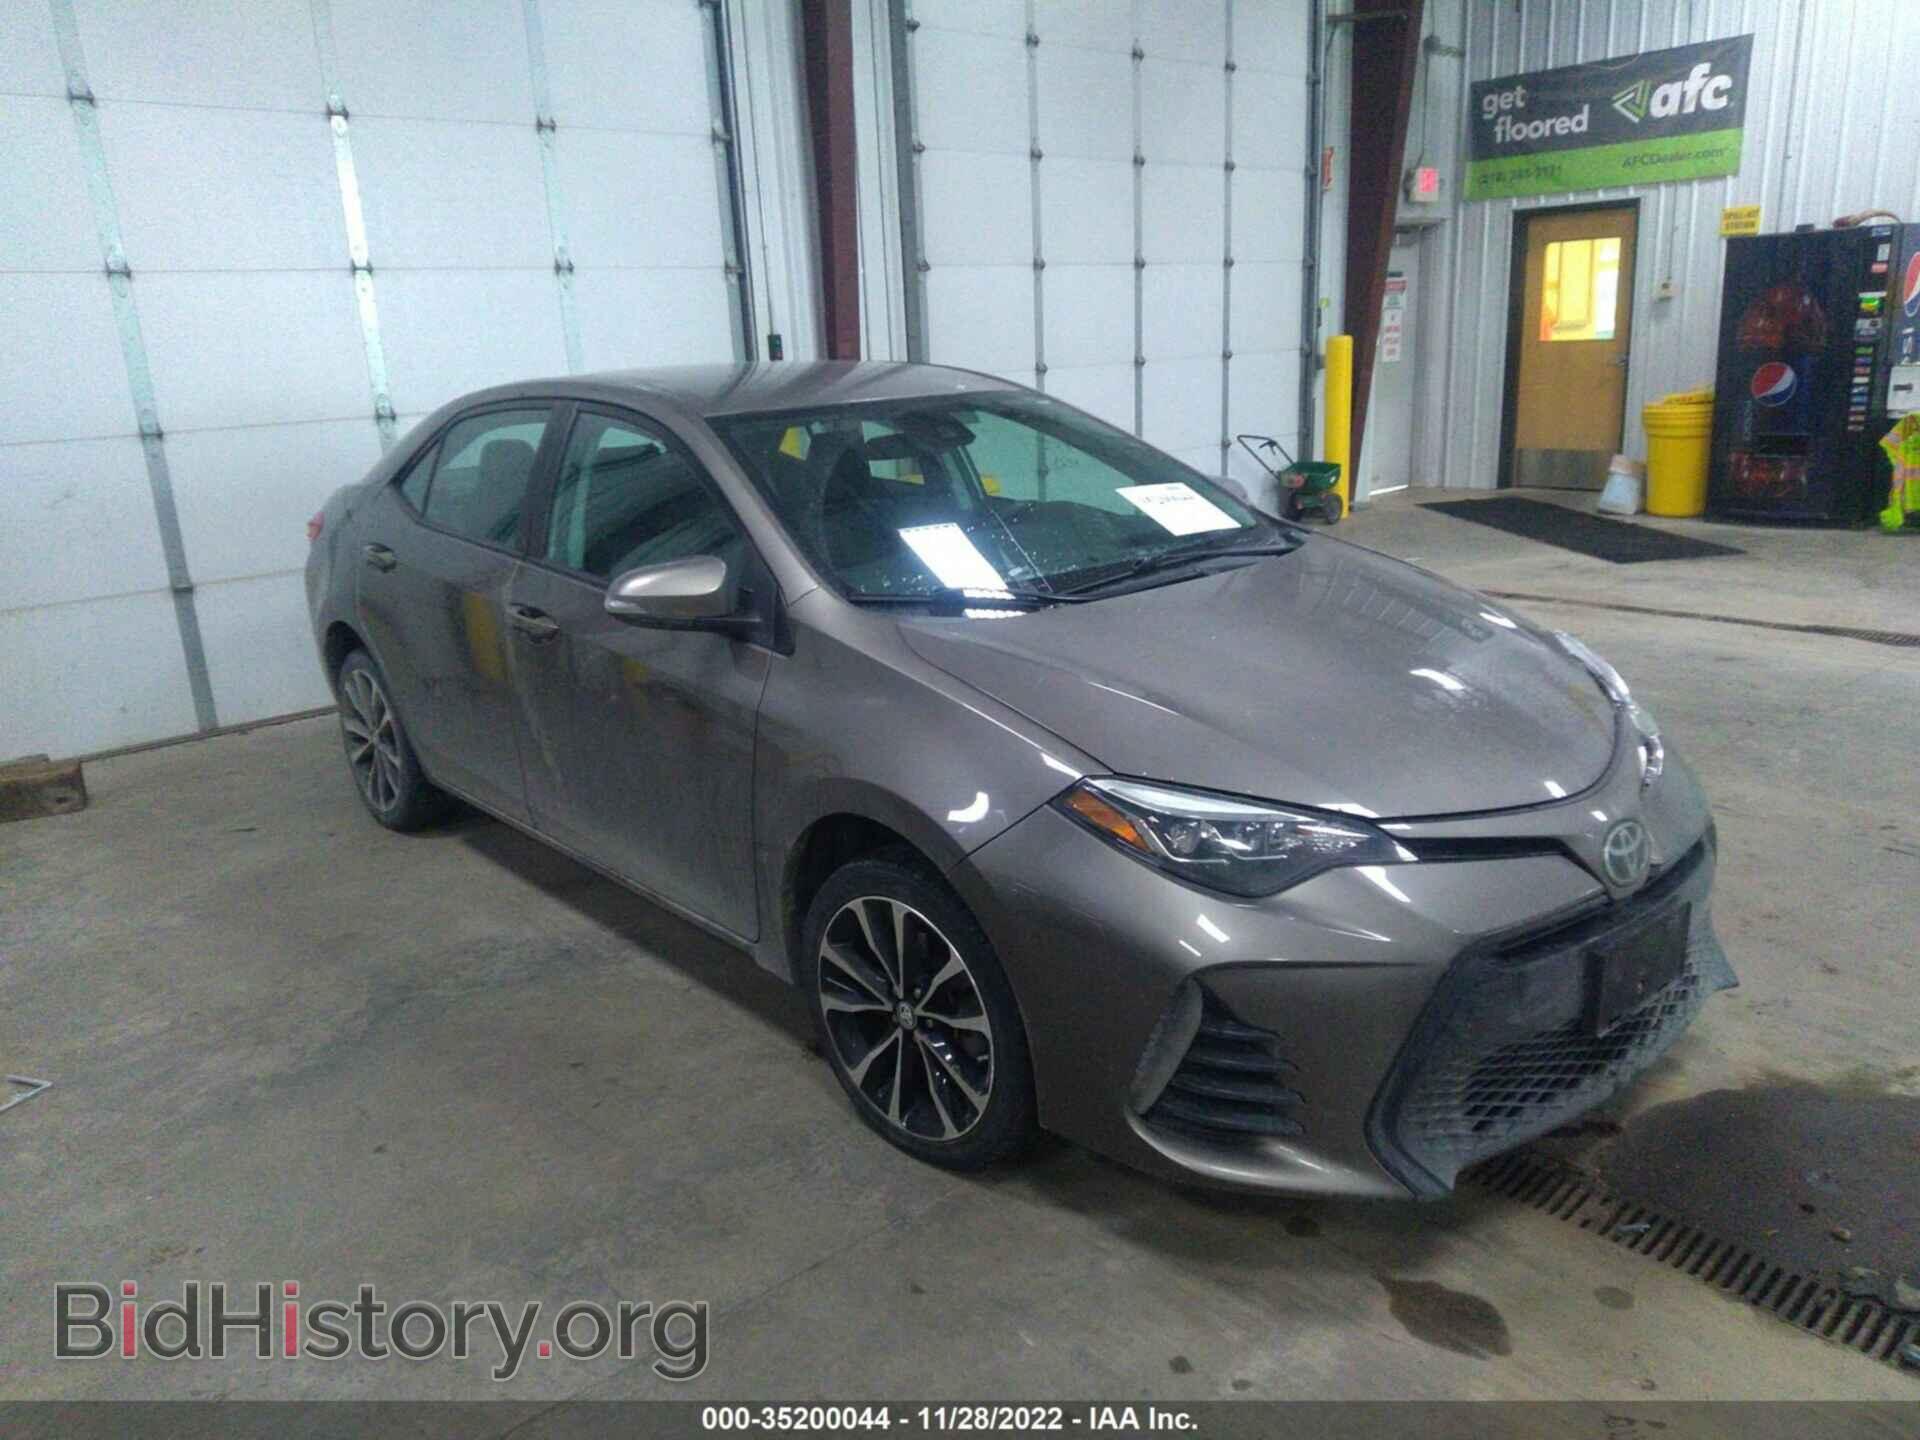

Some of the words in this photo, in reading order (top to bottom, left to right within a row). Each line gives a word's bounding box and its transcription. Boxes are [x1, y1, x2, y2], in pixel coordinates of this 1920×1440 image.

[1482, 85, 1526, 119] get
[1649, 62, 1733, 119] afc
[1494, 104, 1590, 144] floored
